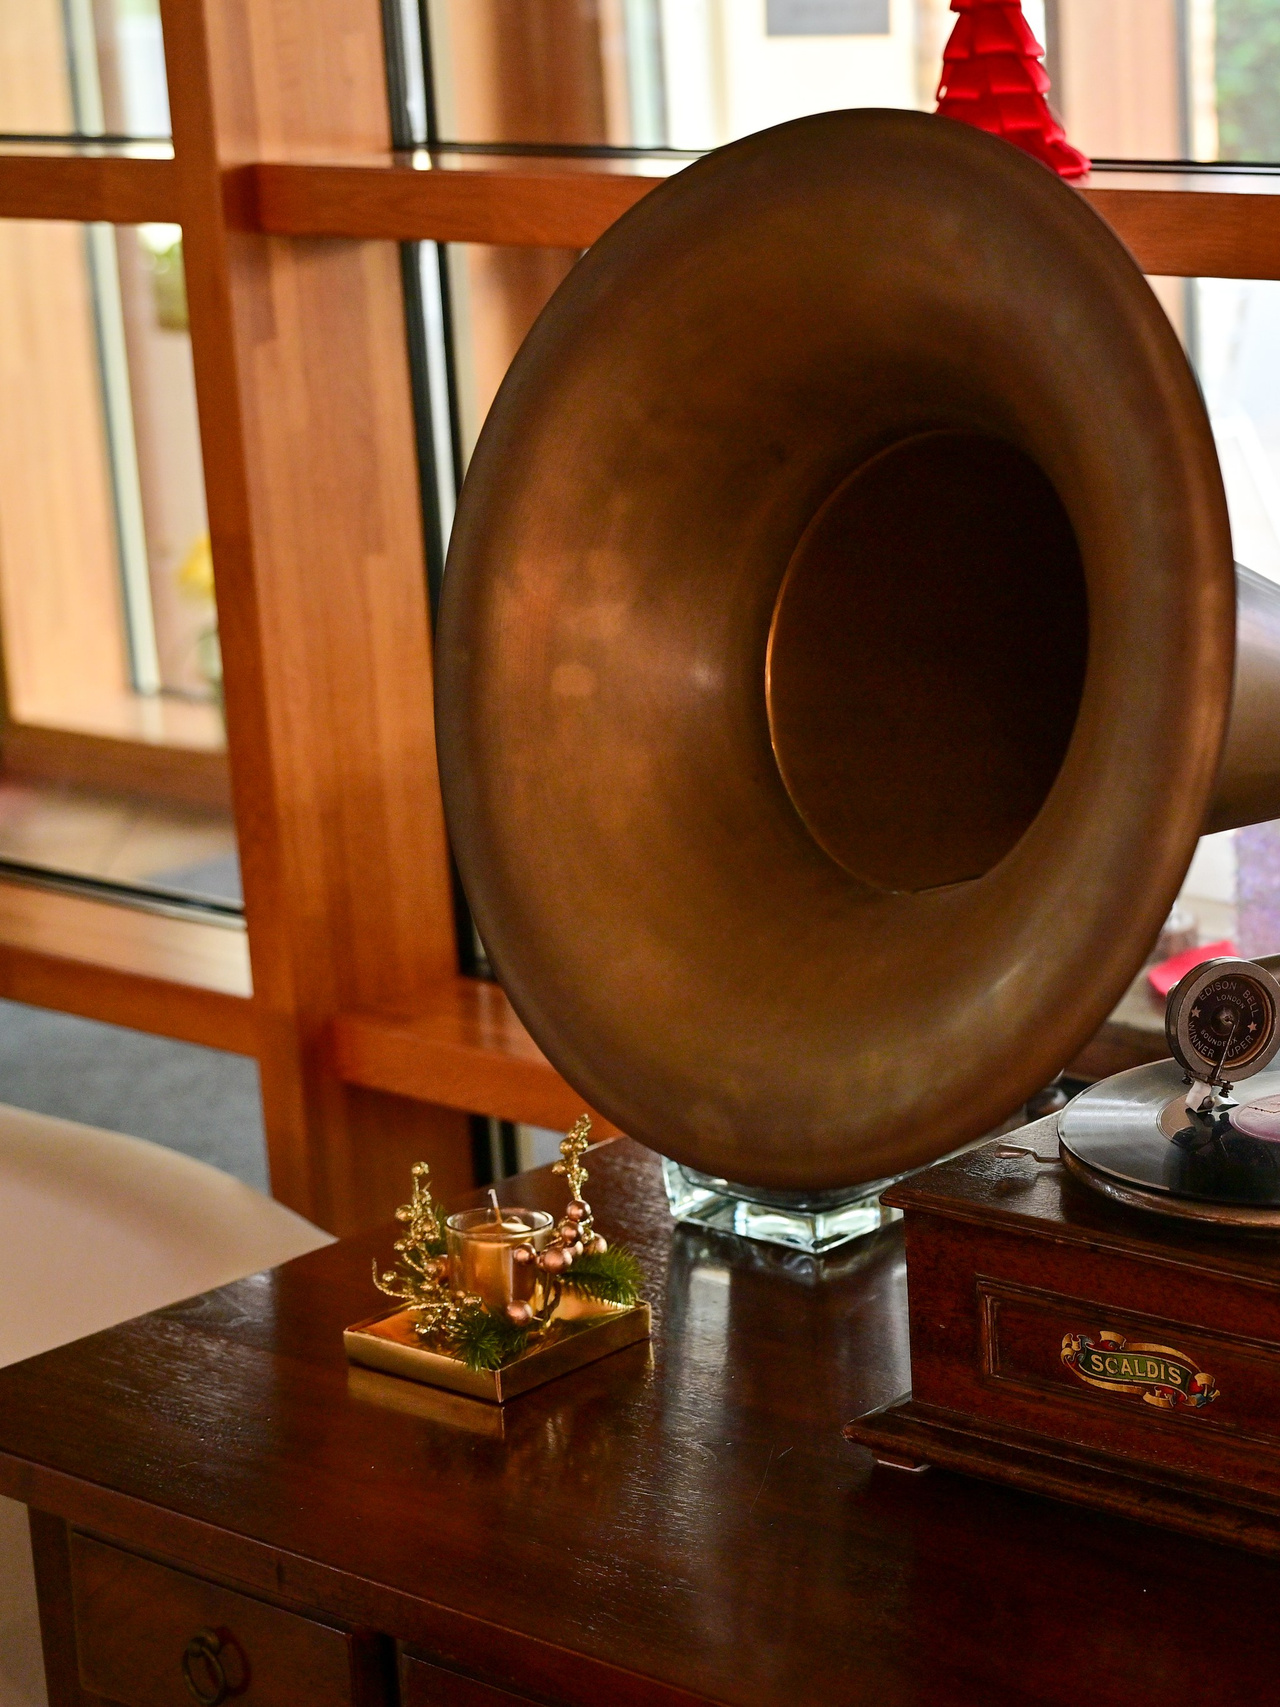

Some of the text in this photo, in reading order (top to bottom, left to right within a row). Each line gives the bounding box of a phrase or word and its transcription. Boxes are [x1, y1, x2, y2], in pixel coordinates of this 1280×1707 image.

[1198, 980, 1259, 1018] EDISON BELL
[1216, 994, 1246, 1009] LONDON
[1188, 1020, 1254, 1058] WINNER UPER
[1090, 1353, 1183, 1386] SCALDIS
